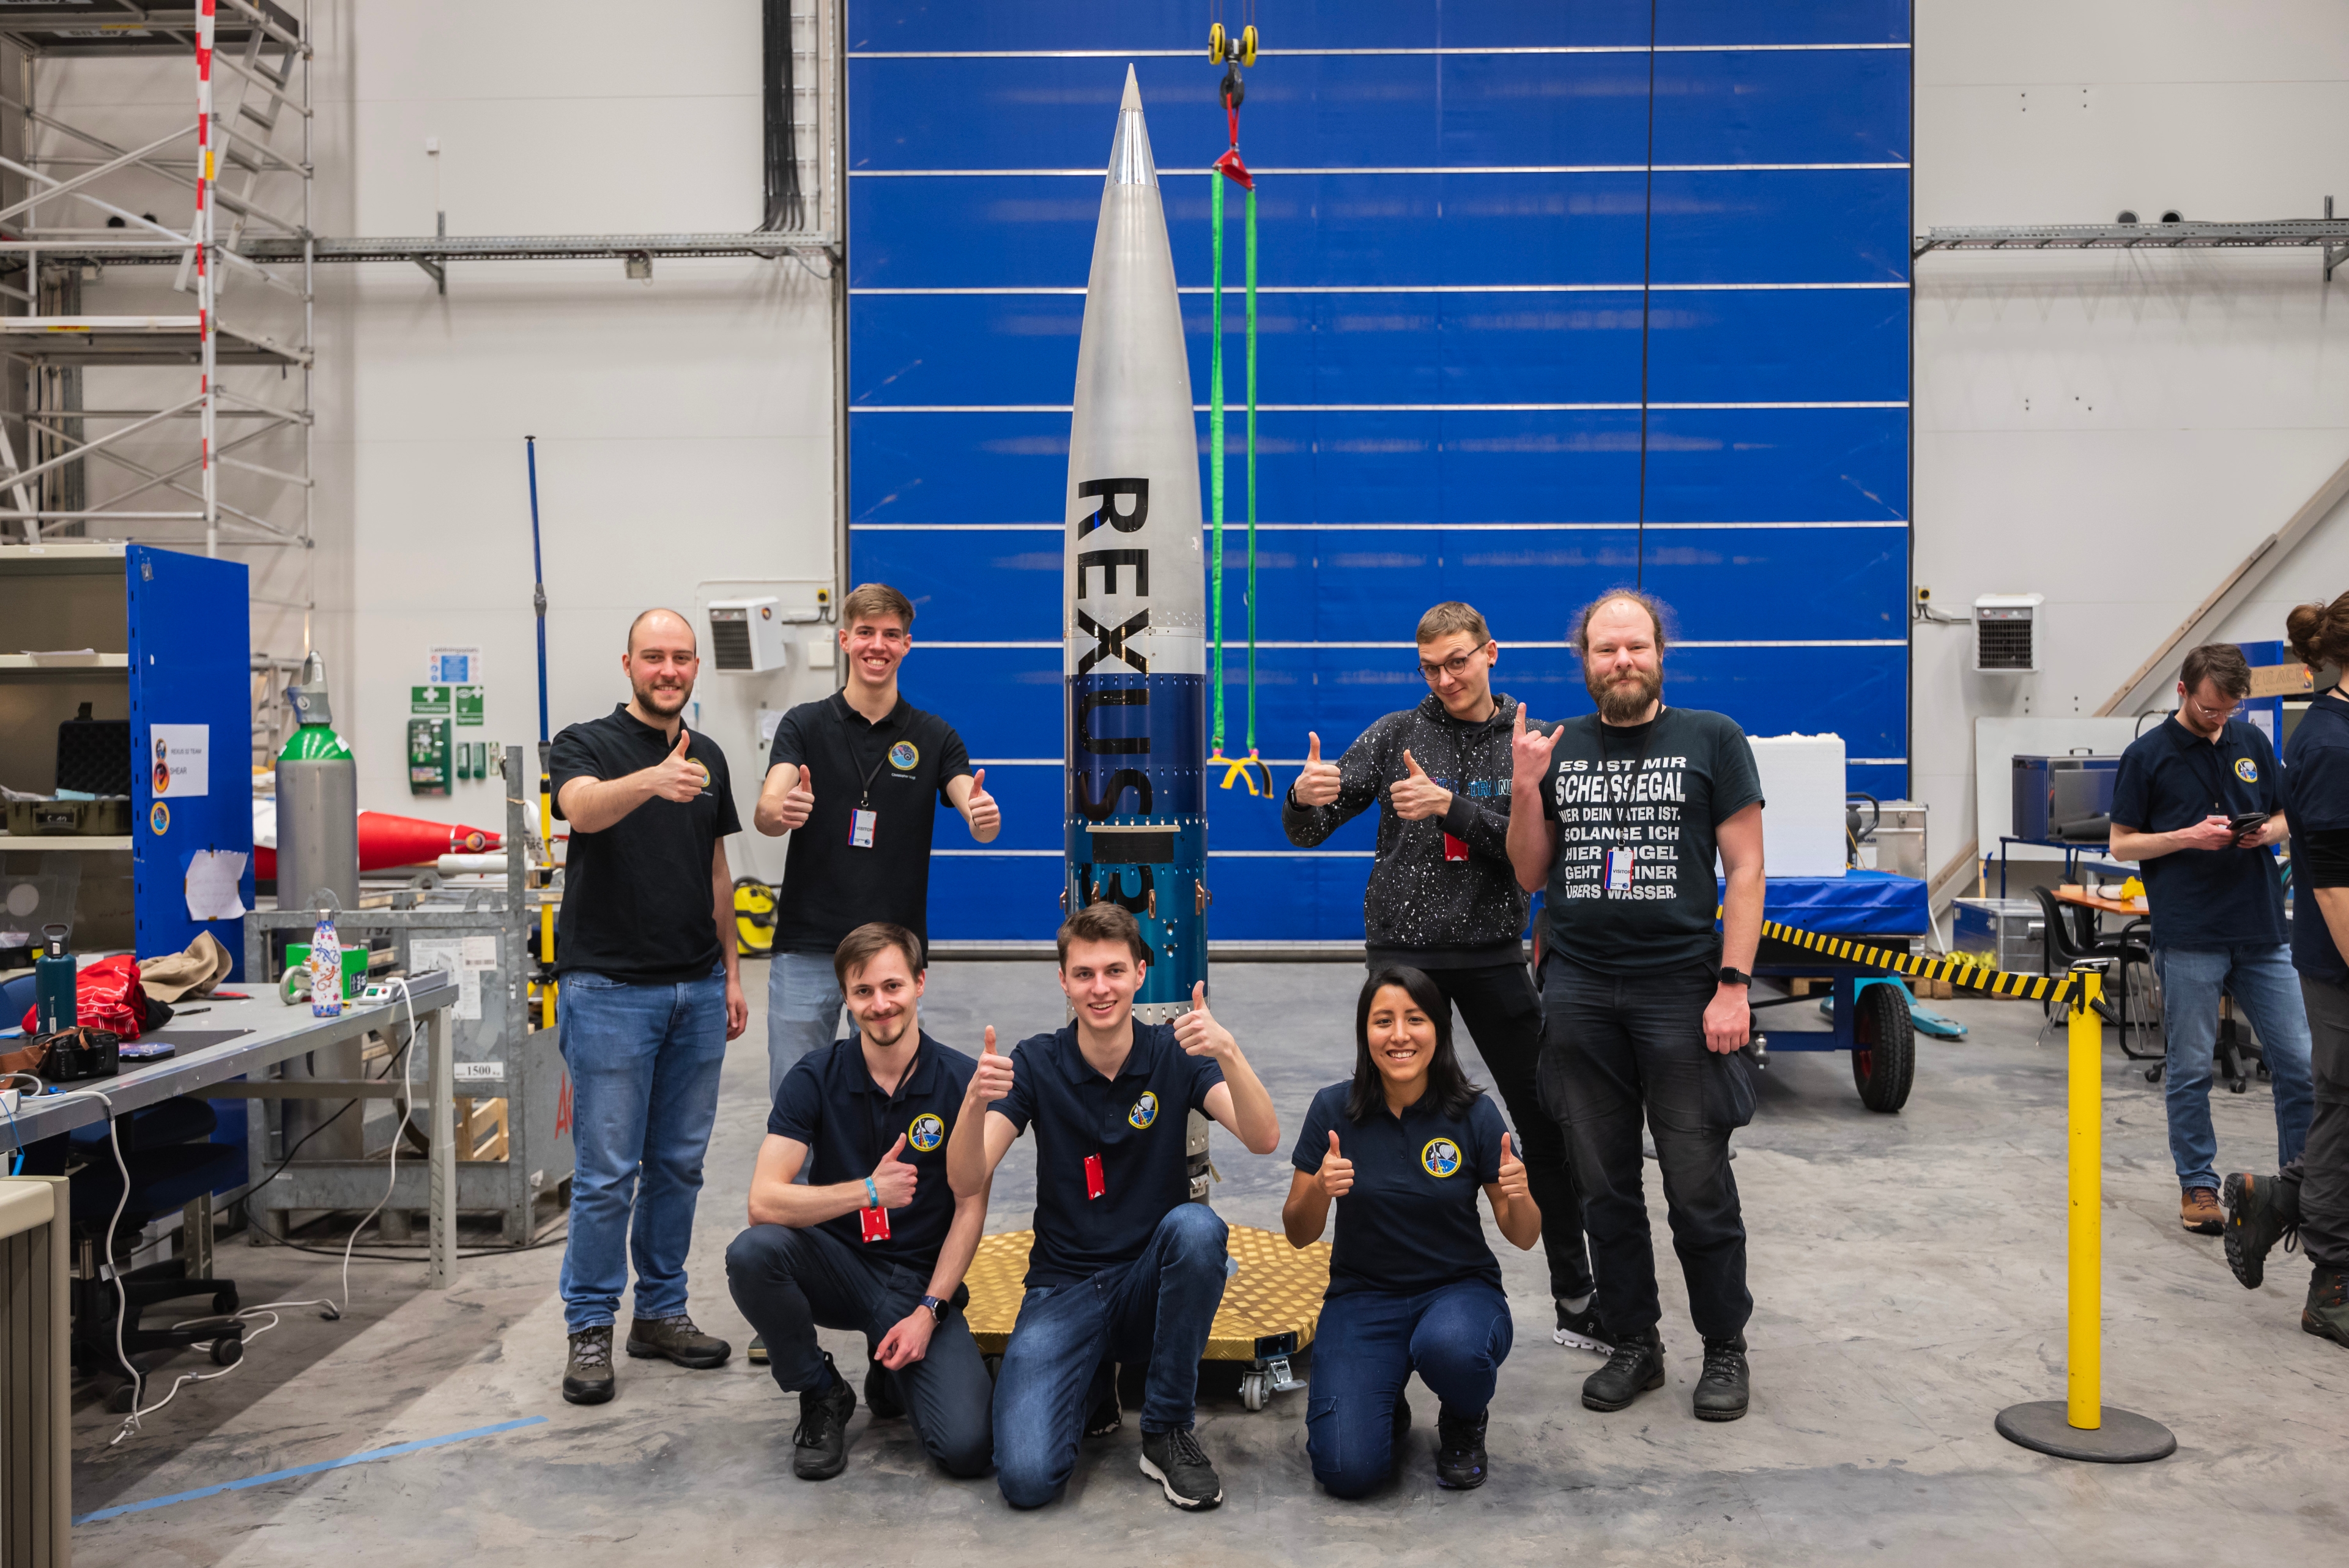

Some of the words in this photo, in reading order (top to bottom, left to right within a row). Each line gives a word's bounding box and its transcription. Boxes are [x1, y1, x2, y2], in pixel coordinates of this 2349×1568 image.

[1077, 477, 1154, 822] REXUS
[1558, 760, 1589, 773] ES
[1642, 756, 1687, 770] MIR
[1558, 808, 1579, 823] WER
[1583, 807, 1612, 822] DEIN
[1658, 806, 1681, 821] IST.
[1565, 827, 1642, 842] SOLANGE
[1648, 826, 1680, 841] ICH
[1565, 845, 1602, 861] HIER
[1565, 864, 1602, 880] GEHT
[1565, 881, 1601, 899] ÜBERS
[467, 1065, 491, 1076] 1500
